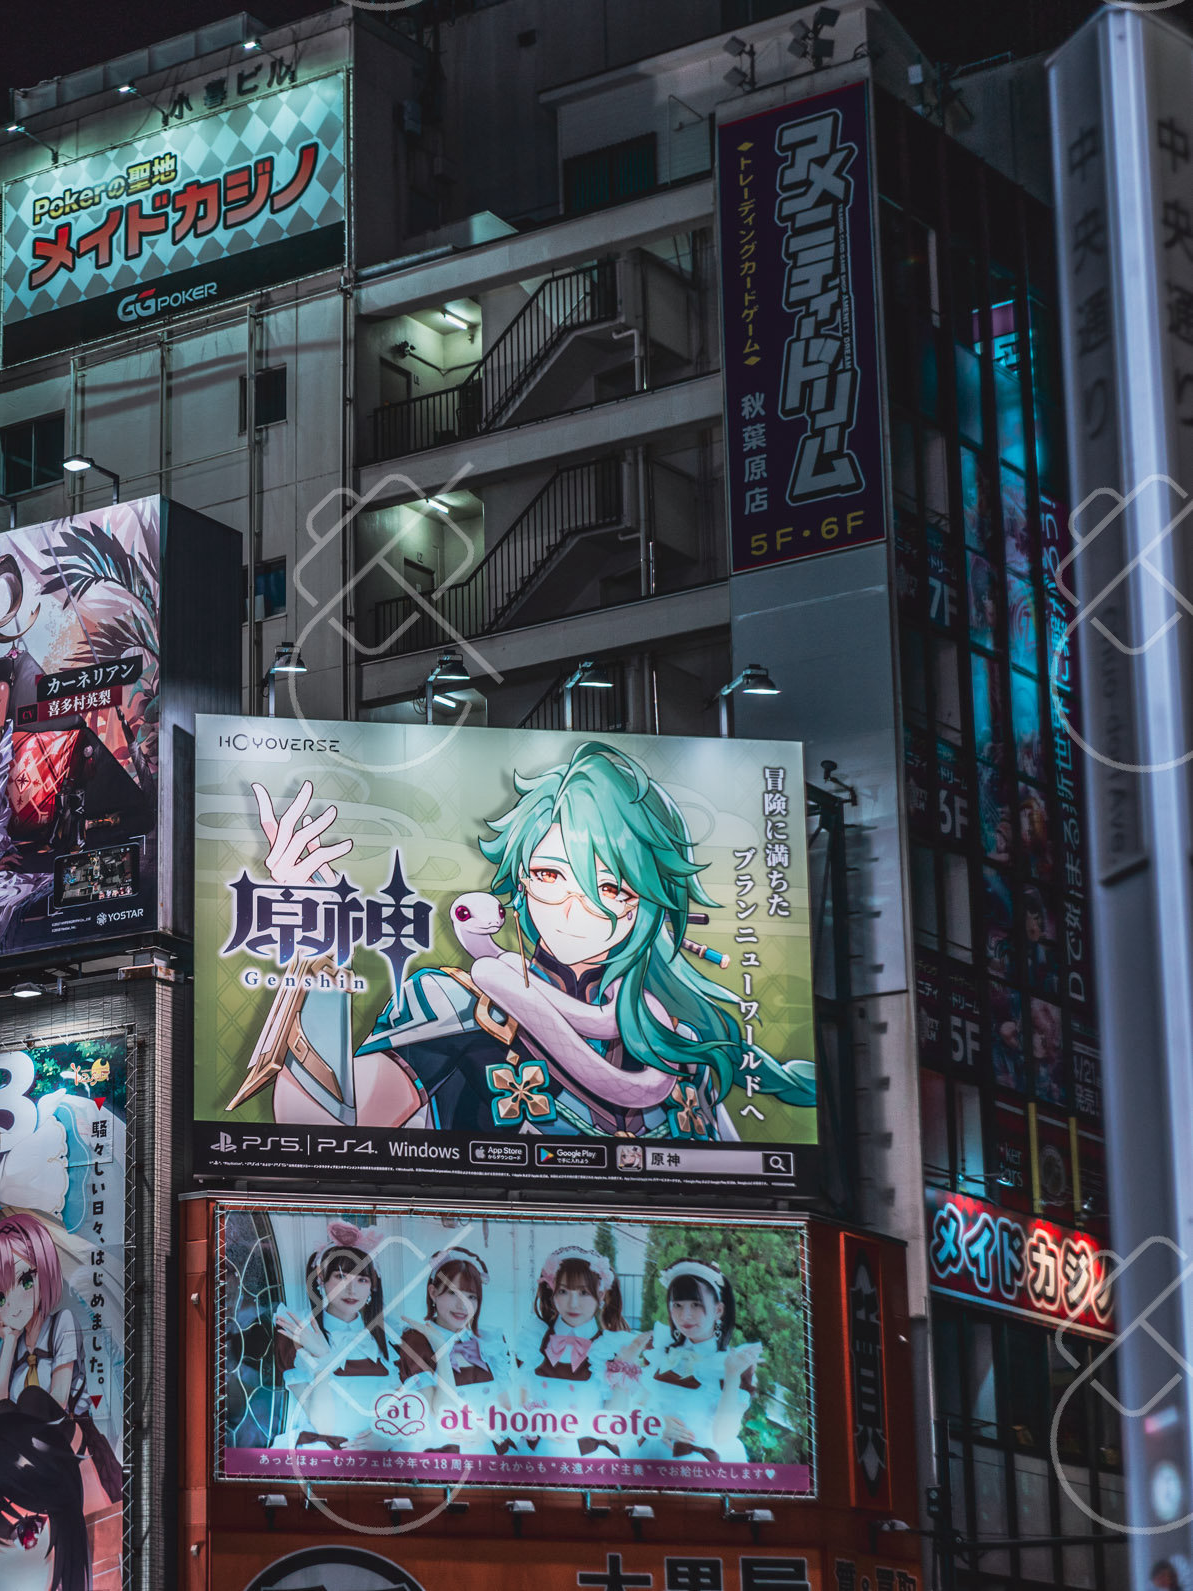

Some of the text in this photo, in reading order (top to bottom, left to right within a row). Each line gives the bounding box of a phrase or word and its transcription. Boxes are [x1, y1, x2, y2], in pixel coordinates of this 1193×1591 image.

[29, 142, 319, 290] メイドカジノ
[737, 156, 762, 356] トレーディングカードゲーム
[776, 109, 866, 506] アメニティドリーム
[741, 391, 768, 516] 秋葉原店
[928, 576, 957, 628] 7F
[47, 663, 135, 696] カーネリアン
[47, 689, 112, 717] 喜多村英梨
[763, 767, 791, 918] 冒険に満ちた
[107, 908, 144, 921] YOSTAR
[219, 848, 434, 1012] 原神
[244, 968, 366, 990] Genshin
[734, 848, 765, 1122] ブランニューワールドへ
[389, 1141, 460, 1160] Windows
[488, 1147, 523, 1156] App Store
[556, 1149, 597, 1160] Google Play
[650, 1152, 681, 1167] 原神
[592, 1405, 664, 1438] cafe
